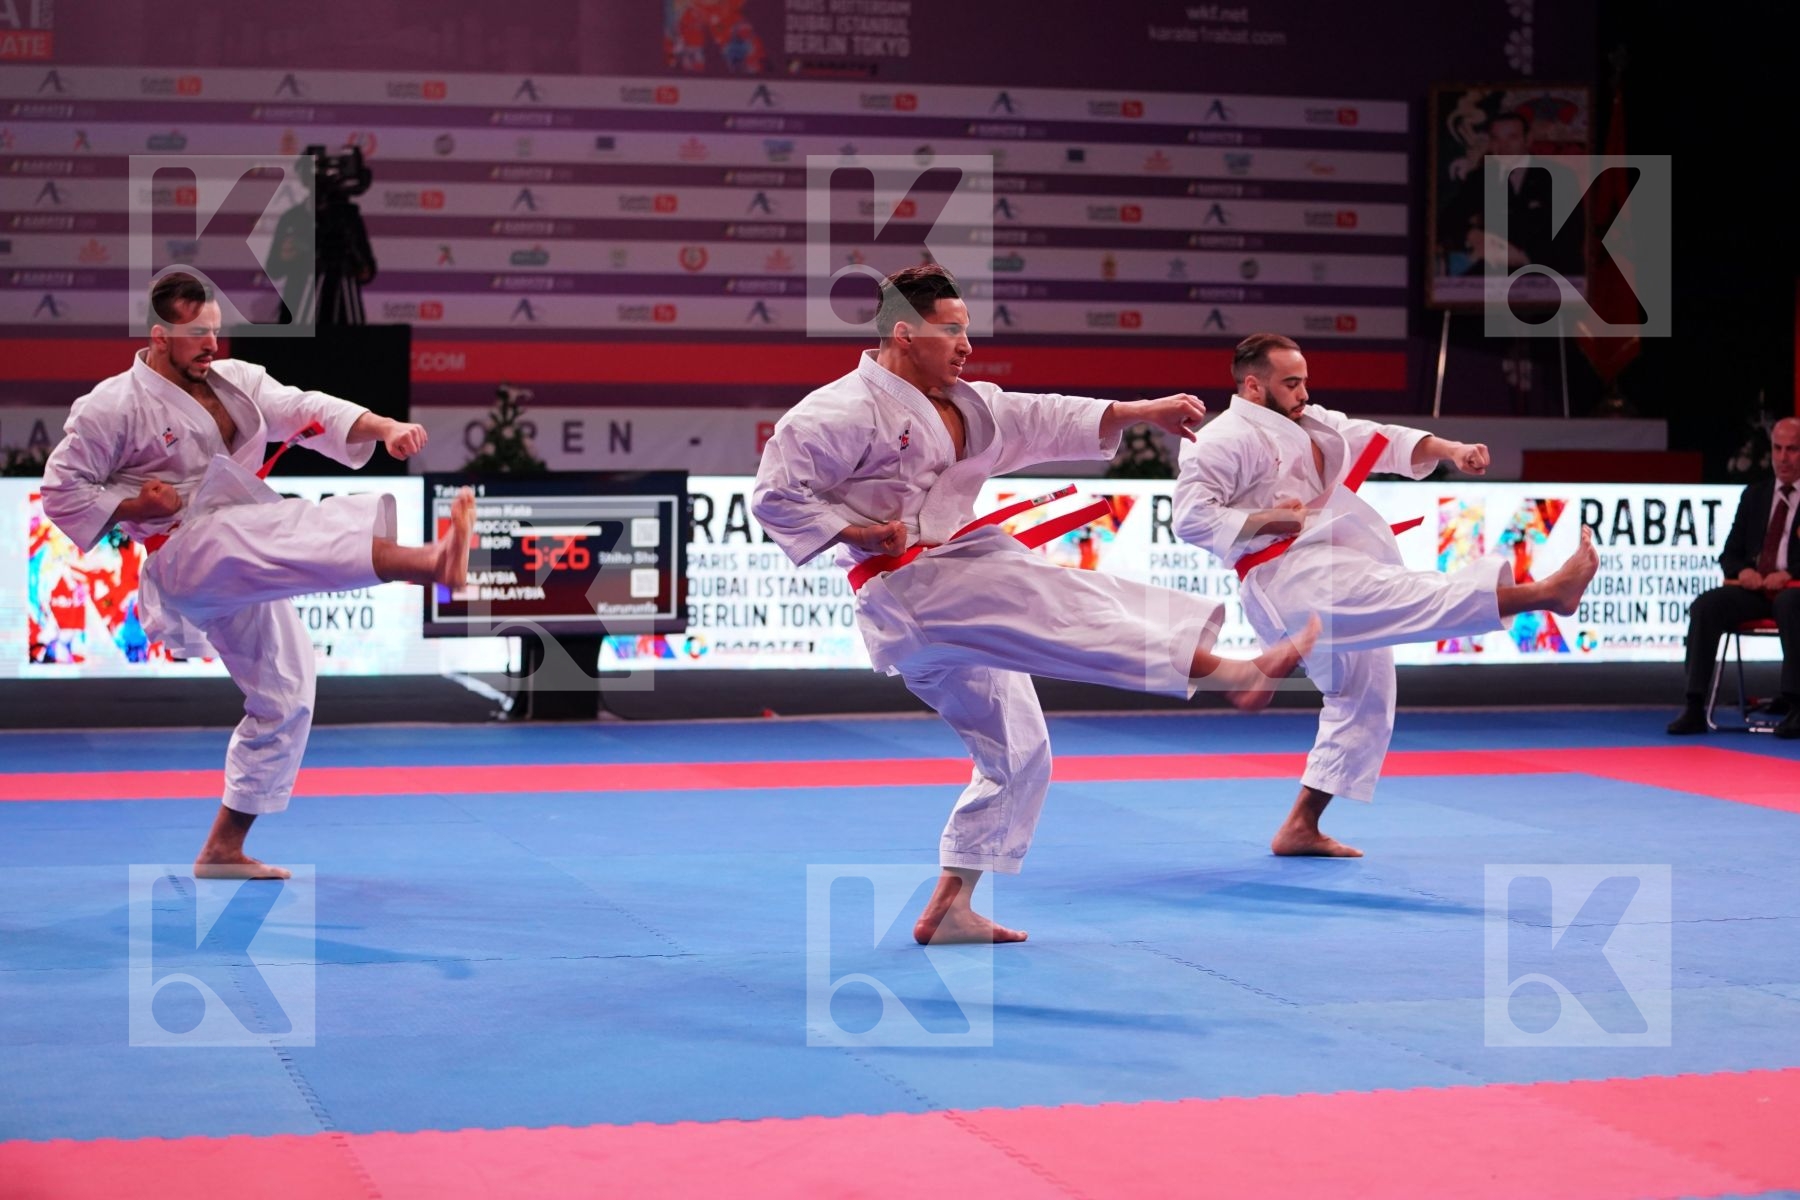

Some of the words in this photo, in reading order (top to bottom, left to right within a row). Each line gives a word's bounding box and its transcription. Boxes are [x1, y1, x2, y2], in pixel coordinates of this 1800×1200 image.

[784, 34, 848, 55] BERLIN
[852, 36, 911, 57] TOKYO
[1580, 498, 1722, 546] RABAT
[481, 536, 512, 549] MOR
[521, 535, 591, 571] 5:26
[687, 554, 738, 570] PARIS
[1150, 551, 1199, 569] PARIS
[1600, 555, 1624, 571] RIS
[1632, 554, 1721, 571] ROTTERDAM
[466, 571, 518, 584] ALAYSIA
[688, 577, 748, 597] DUBAI
[757, 577, 853, 597] ISTANBUL
[481, 586, 546, 600] MALAYSIA
[688, 603, 768, 627] BERLIN
[779, 603, 855, 627] TOKYO
[1578, 601, 1648, 624] BERLIN
